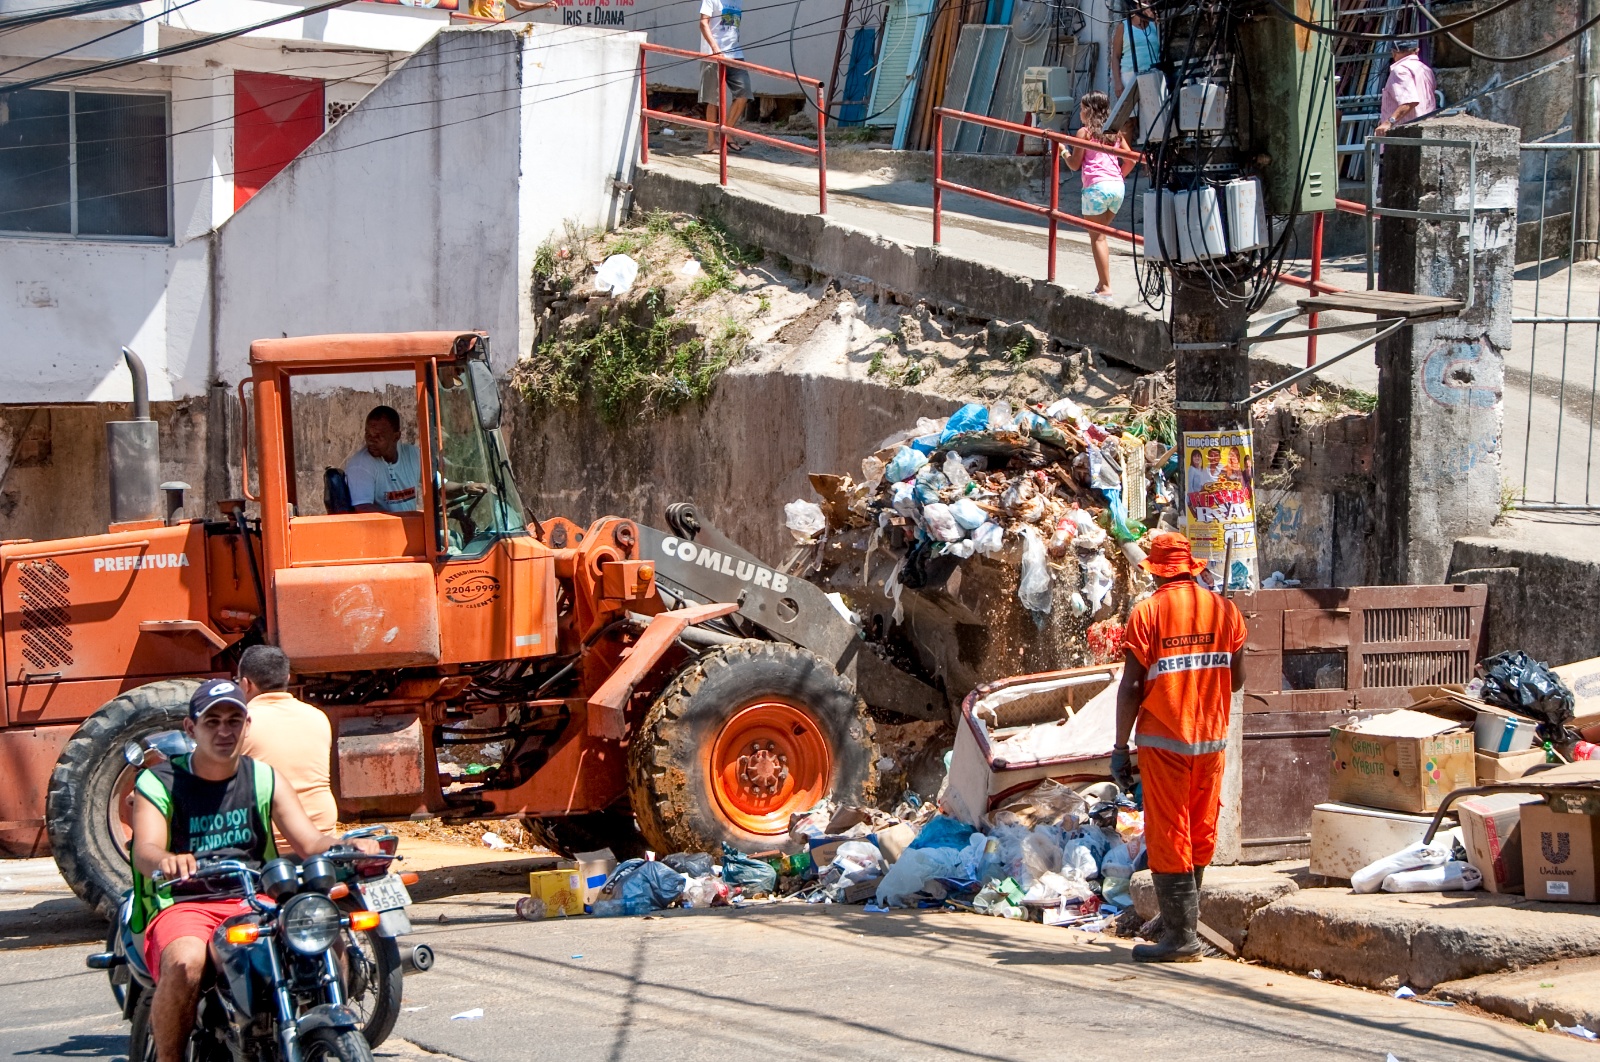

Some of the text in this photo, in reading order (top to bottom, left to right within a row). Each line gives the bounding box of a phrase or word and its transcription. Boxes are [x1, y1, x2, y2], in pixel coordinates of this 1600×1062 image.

[563, 7, 582, 25] IRIS
[594, 6, 625, 25] DIANA
[1220, 434, 1231, 446] da
[93, 553, 190, 572] PREFEITURA
[661, 536, 789, 593] COMLURB
[445, 584, 500, 595] 2204-9999
[1351, 736, 1382, 759] GRANJA
[189, 808, 248, 834] MOTO BOY
[1539, 866, 1577, 876] Unilever
[368, 884, 400, 900] KML
